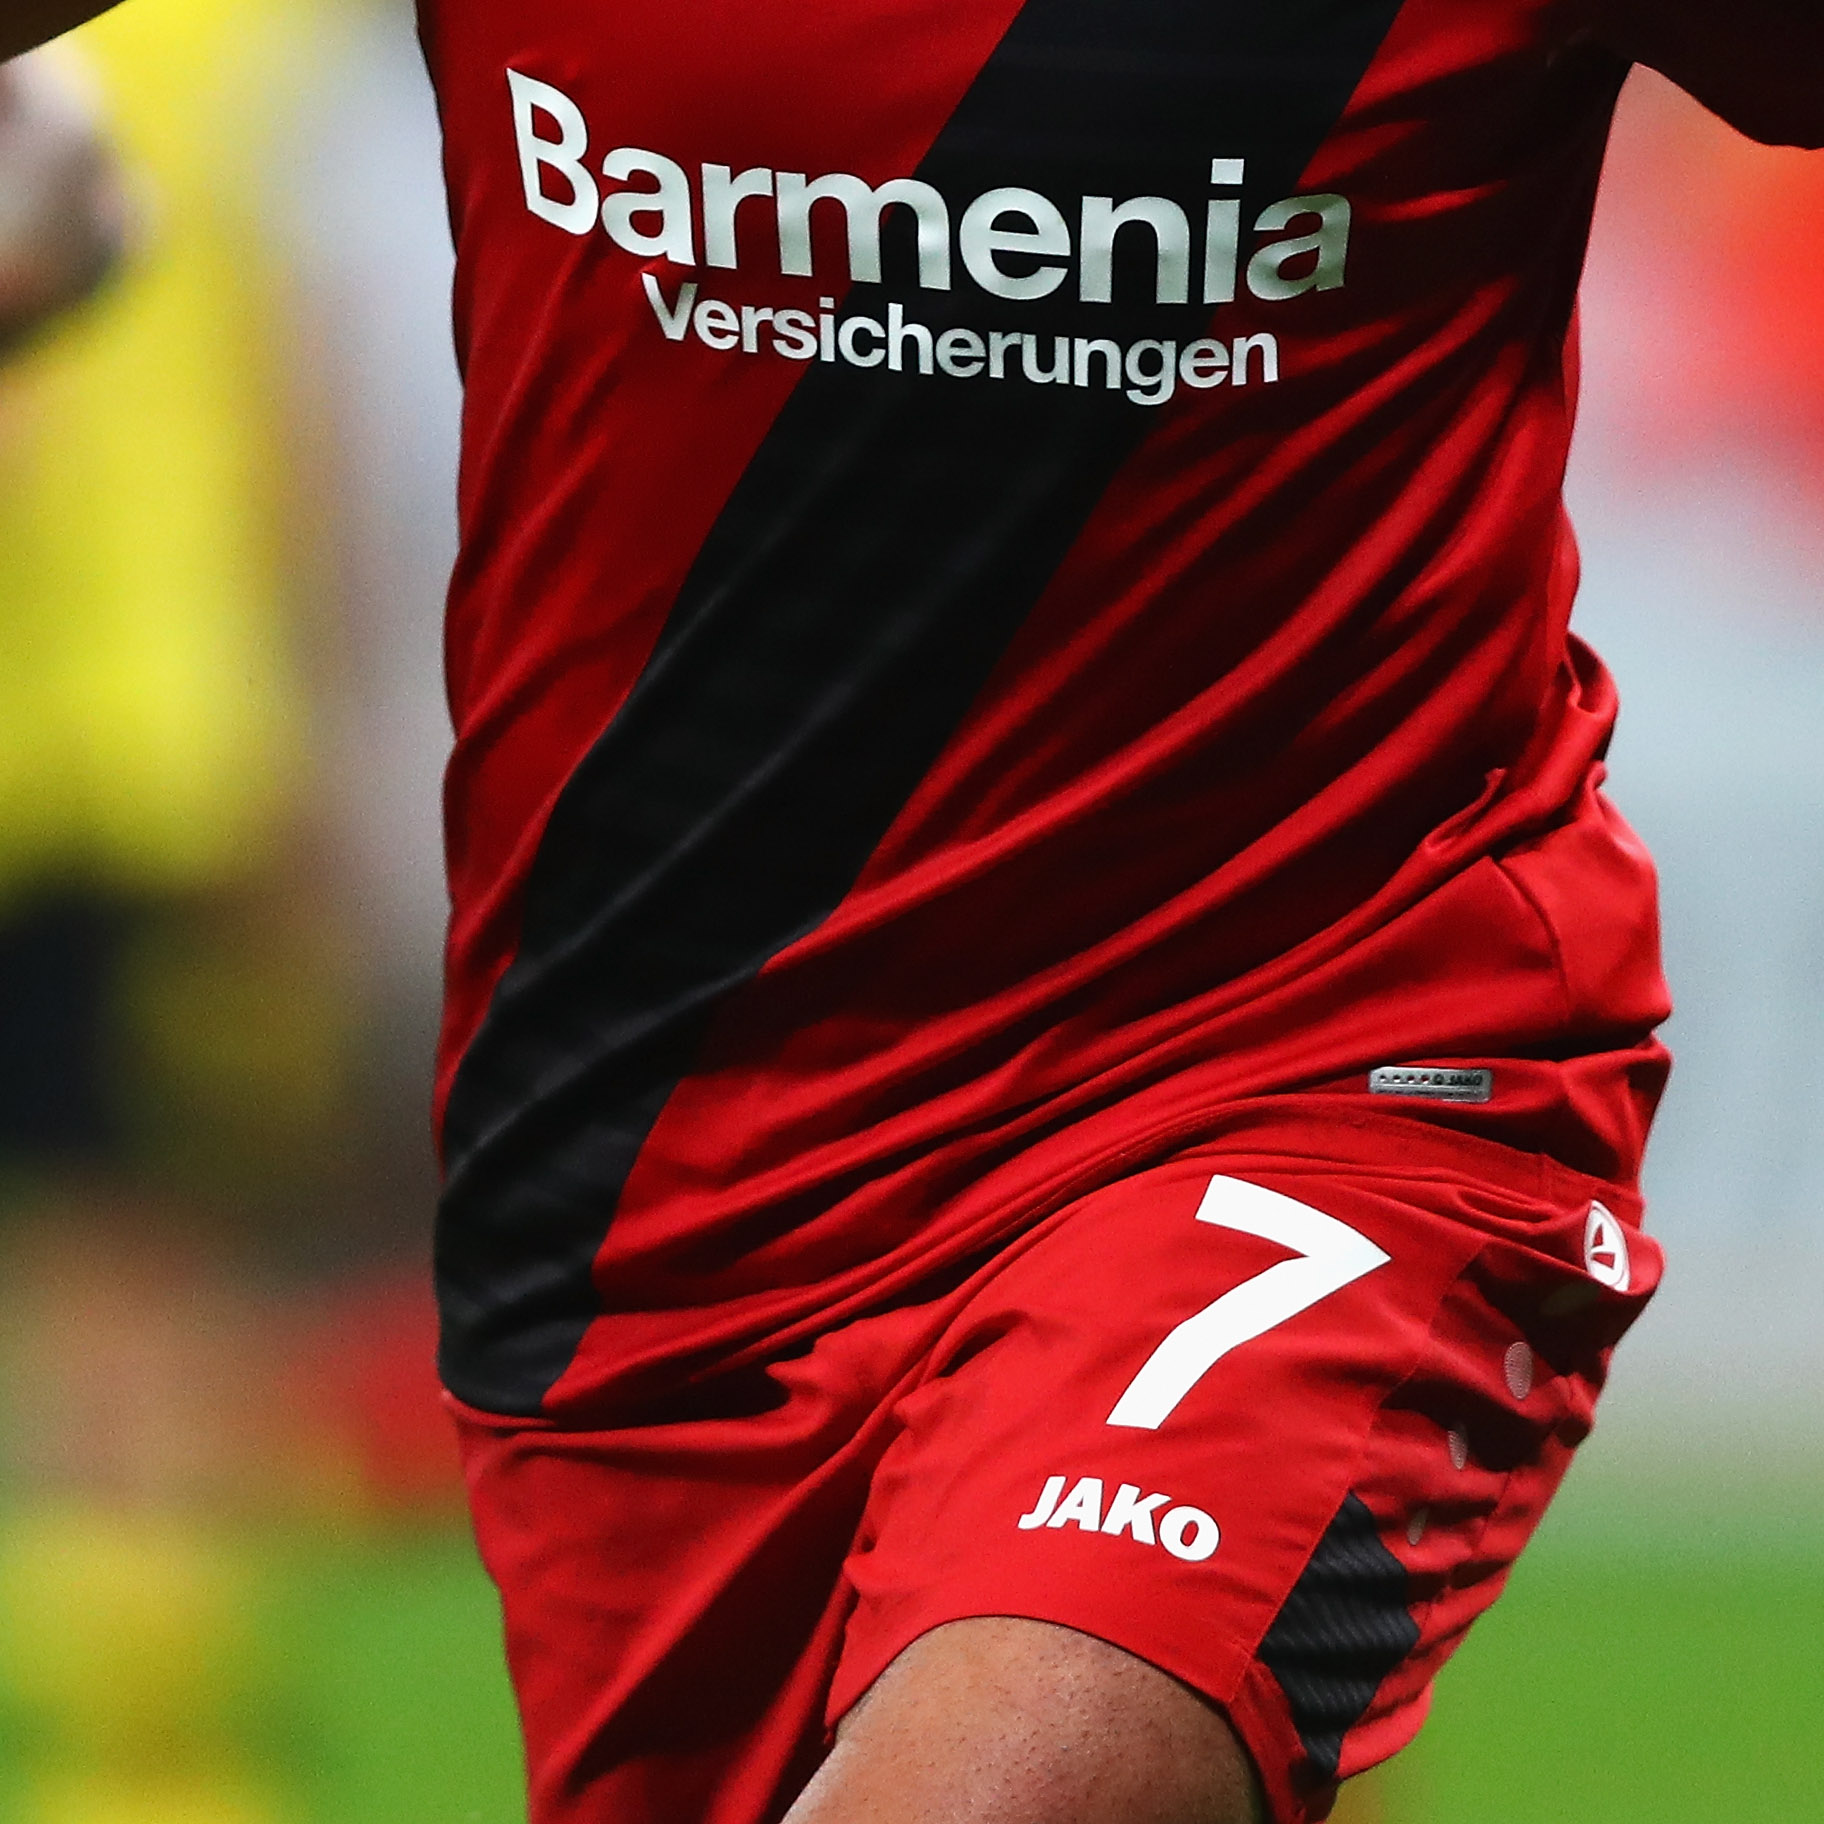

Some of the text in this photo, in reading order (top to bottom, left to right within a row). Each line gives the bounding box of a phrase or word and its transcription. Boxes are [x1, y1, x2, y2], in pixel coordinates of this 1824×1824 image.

[507, 67, 1352, 305] Barmenia
[641, 272, 1279, 406] Versicherungen
[1105, 1174, 1392, 1430] 7
[1017, 1475, 1220, 1563] JAKO
